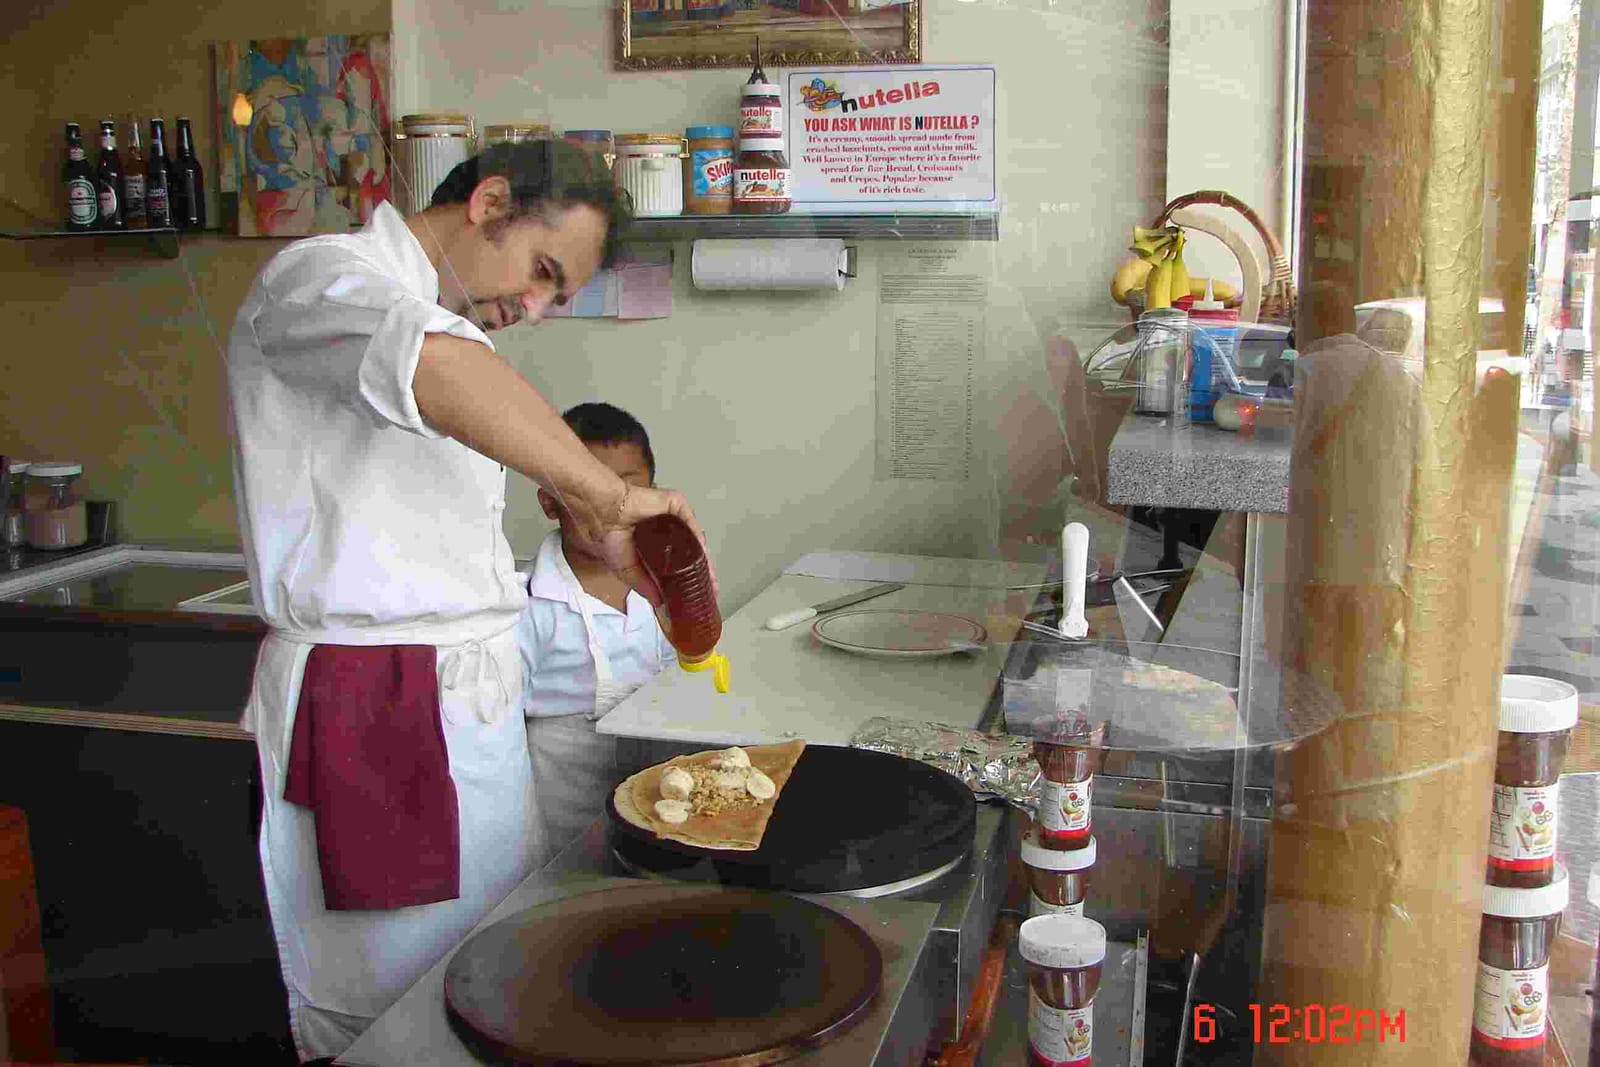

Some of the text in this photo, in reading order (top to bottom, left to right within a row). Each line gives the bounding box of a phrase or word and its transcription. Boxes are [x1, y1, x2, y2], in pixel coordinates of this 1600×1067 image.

[840, 80, 940, 113] nutella
[804, 118, 829, 132] YOU
[832, 117, 857, 131] ASK
[860, 117, 897, 131] WHAT
[899, 116, 912, 130] IS
[866, 134, 896, 142] smooth
[899, 133, 927, 144] spread
[929, 133, 952, 141] made
[954, 132, 975, 141] from
[914, 144, 930, 152] and
[932, 143, 953, 151] skim
[803, 155, 822, 163] Well
[824, 154, 852, 163] known
[854, 154, 863, 162] in
[865, 154, 896, 164] Europe
[899, 153, 925, 162] where
[948, 153, 982, 161] favorite
[740, 168, 786, 180] nutella
[820, 165, 849, 175] spread
[851, 164, 864, 173] for
[917, 164, 963, 172] Croissants
[830, 175, 847, 183] and
[882, 174, 917, 184] Popular
[919, 173, 953, 182] because
[859, 185, 869, 193] of
[883, 184, 901, 193] rich
